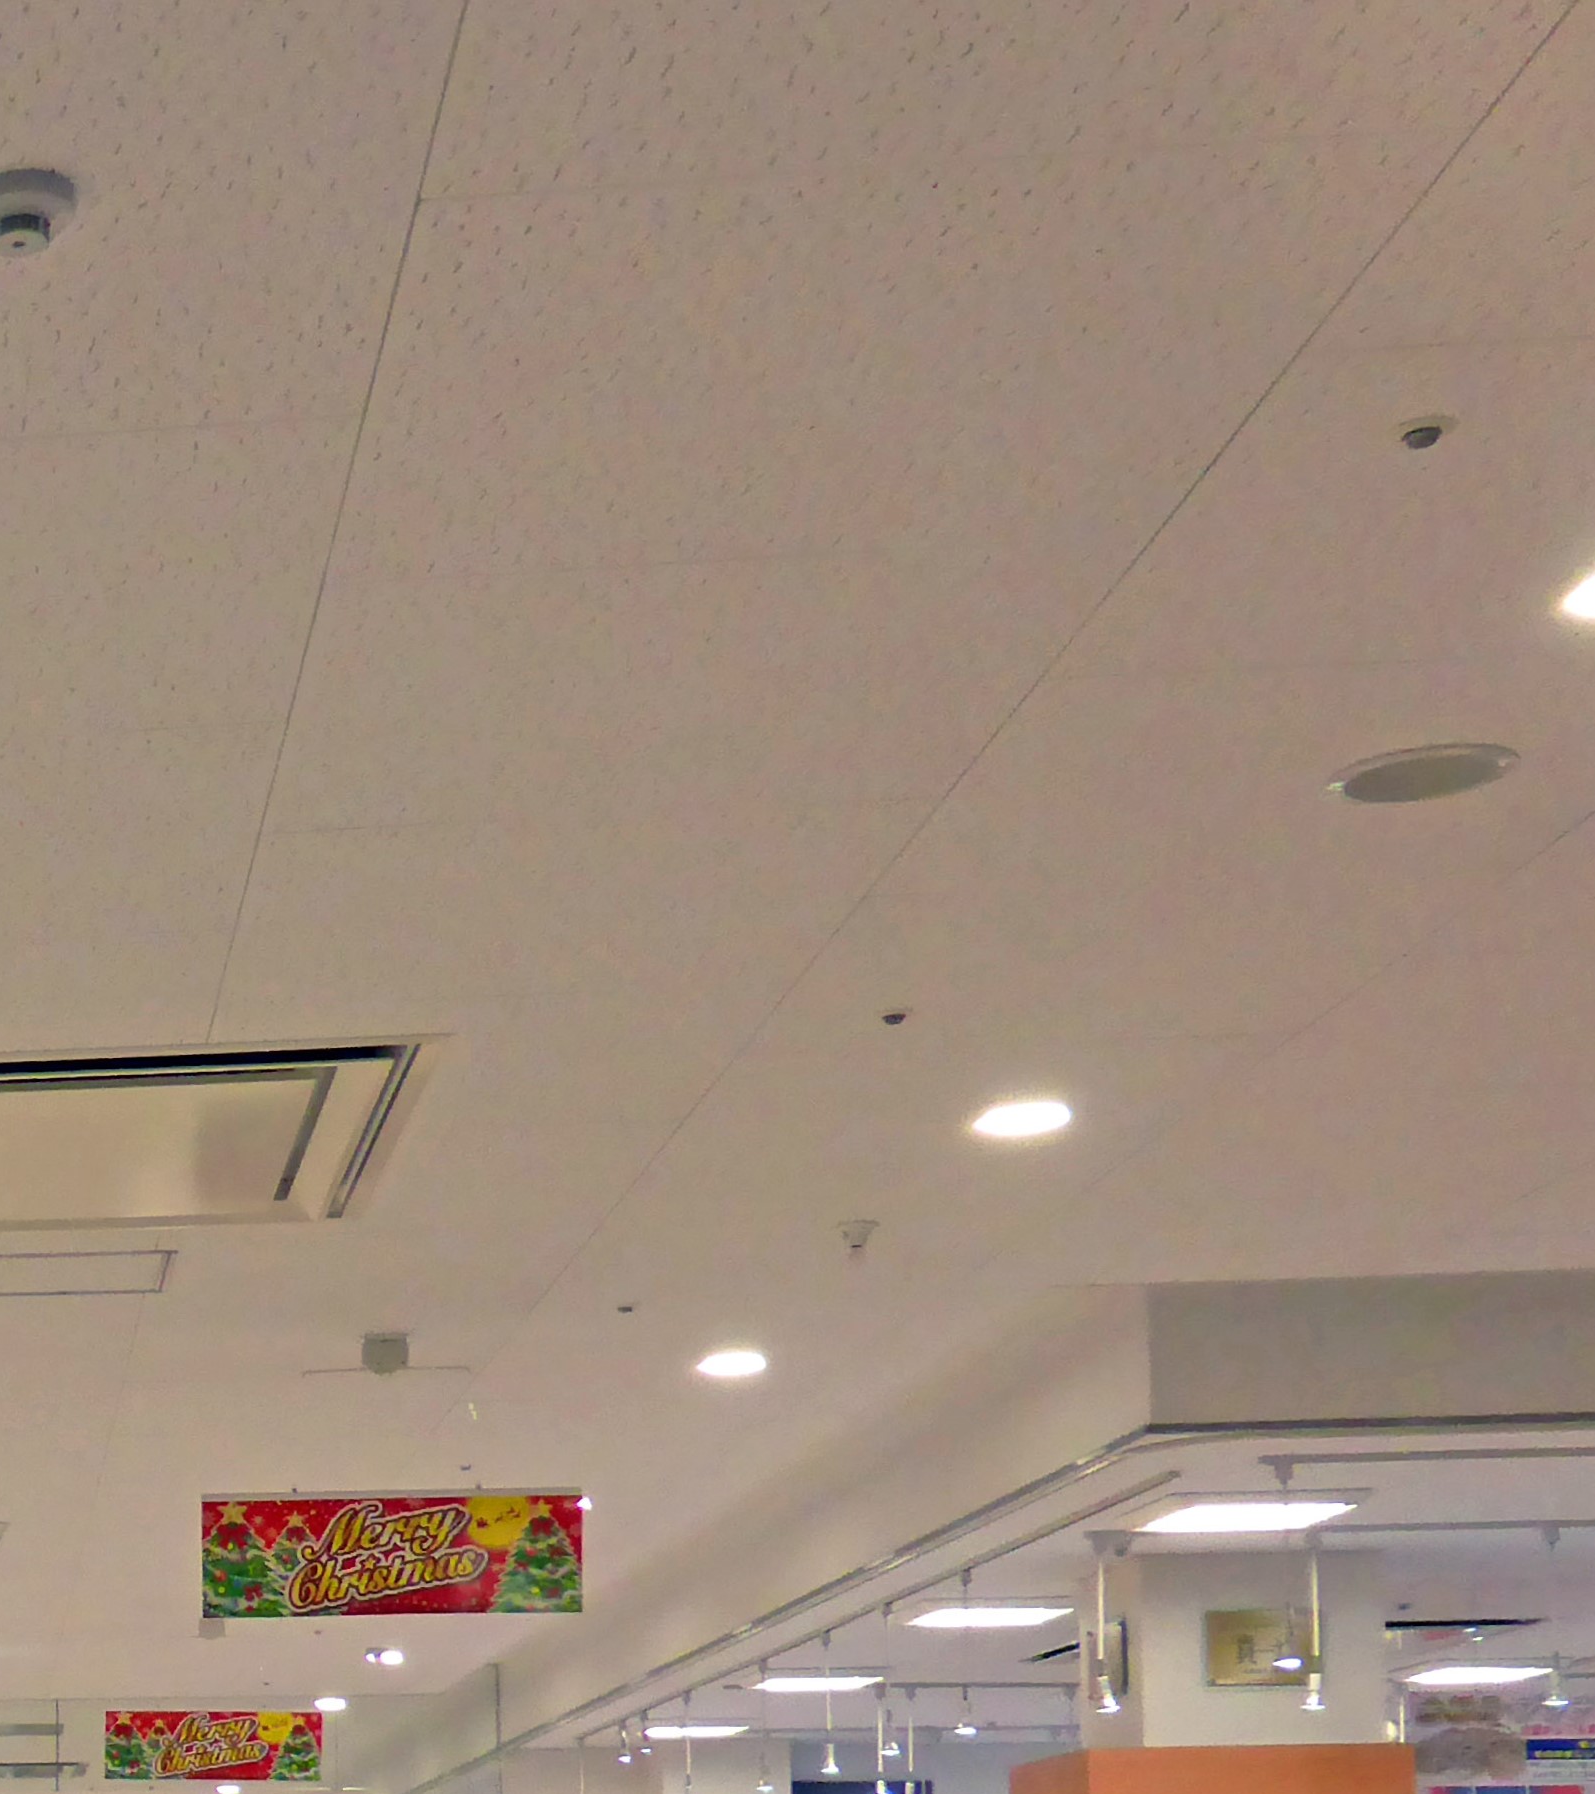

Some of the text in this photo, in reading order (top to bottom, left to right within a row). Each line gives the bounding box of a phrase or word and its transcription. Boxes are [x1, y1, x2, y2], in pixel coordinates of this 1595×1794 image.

[302, 1503, 468, 1556] Merry
[290, 1552, 486, 1610] Christmas
[161, 1714, 257, 1747] Merry
[155, 1742, 266, 1775] Christmas
